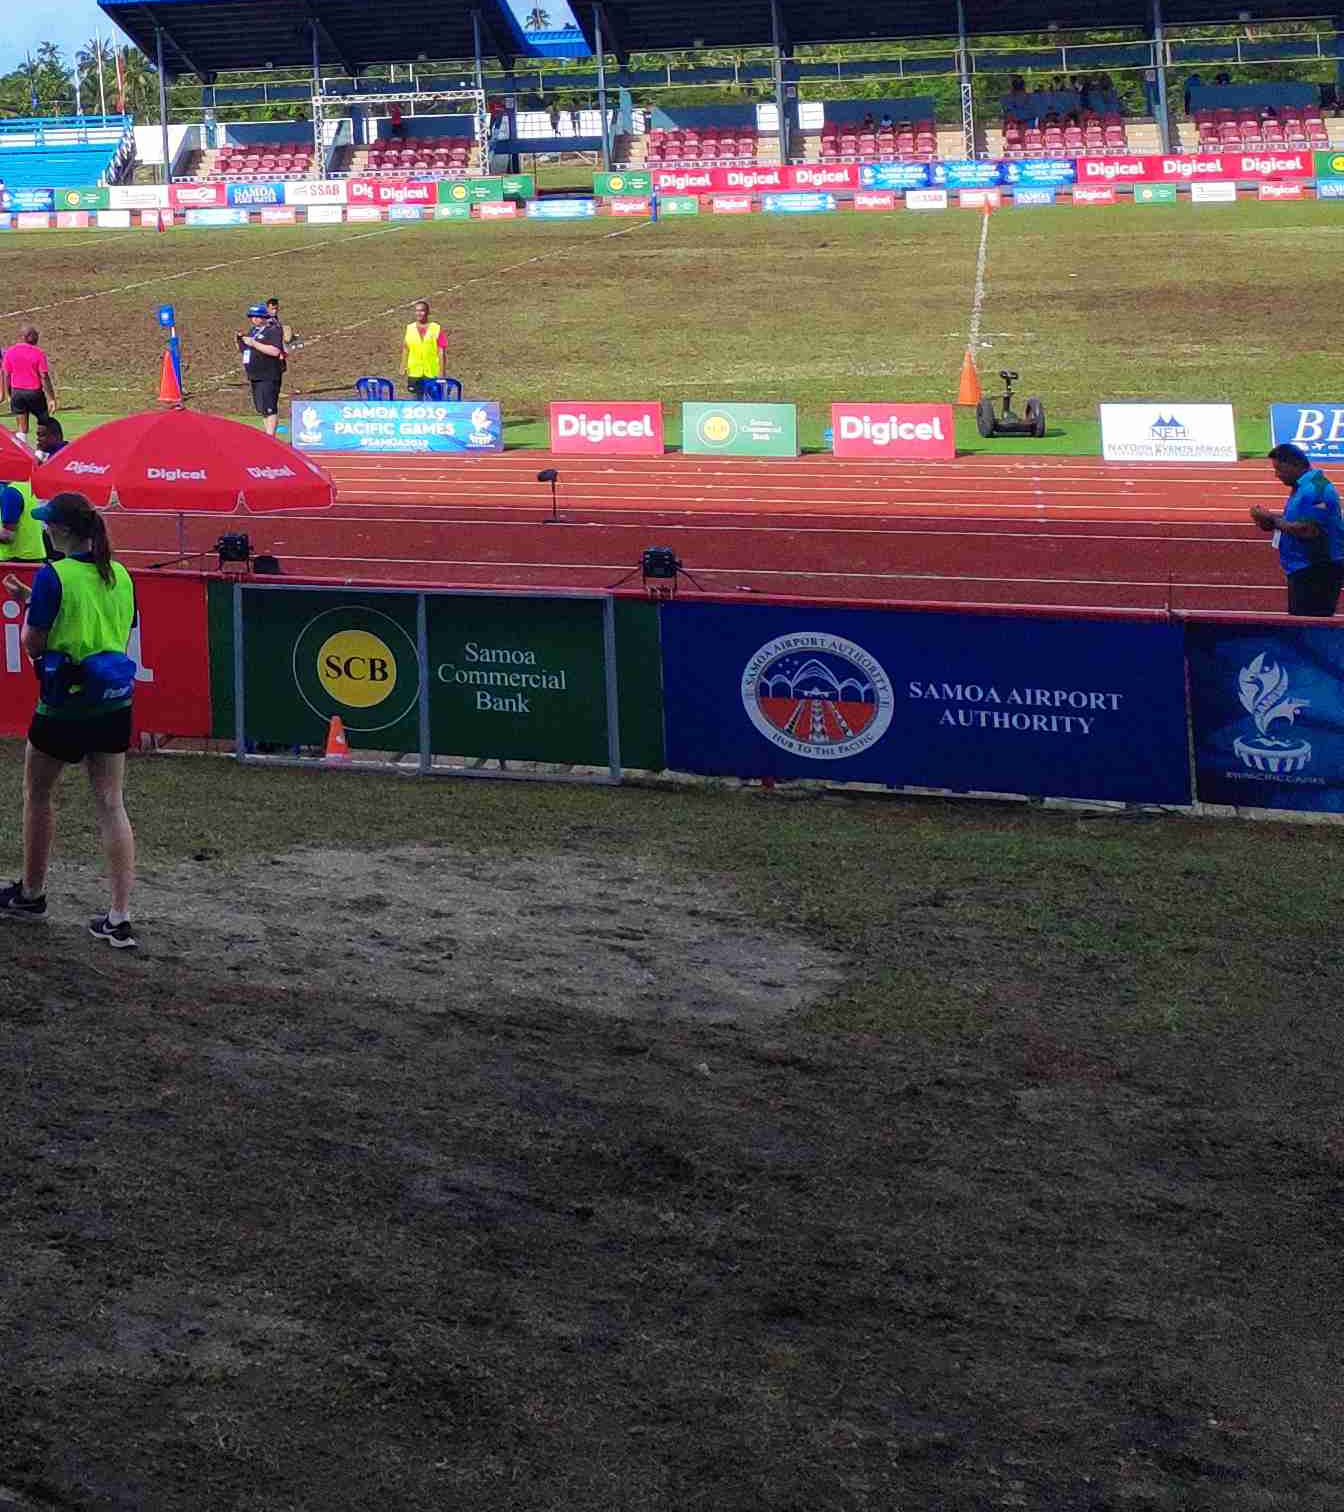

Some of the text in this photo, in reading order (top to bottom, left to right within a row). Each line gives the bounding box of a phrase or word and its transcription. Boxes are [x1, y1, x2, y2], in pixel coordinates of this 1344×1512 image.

[1086, 161, 1145, 179] Digicel
[1163, 159, 1223, 176] Digicel
[1241, 157, 1303, 172] Digicel
[659, 174, 712, 189] Digicel
[727, 172, 781, 187] Digicel
[796, 168, 850, 186] Digicel
[380, 185, 429, 201] Digicel
[343, 406, 448, 421] SAMOA 2019
[334, 422, 456, 437] PACIFIC GAMES
[557, 413, 654, 442] Digicel
[839, 415, 944, 445] Digicel
[146, 467, 207, 482] Digicel
[464, 641, 537, 666] Samoa
[773, 637, 826, 655] AIRPORT
[324, 655, 389, 683] SCB
[438, 663, 568, 691] Commercial
[475, 690, 531, 714] Bank
[908, 681, 1124, 711] SAMOA AIRPORT
[939, 709, 1095, 735] AUTHORITY
